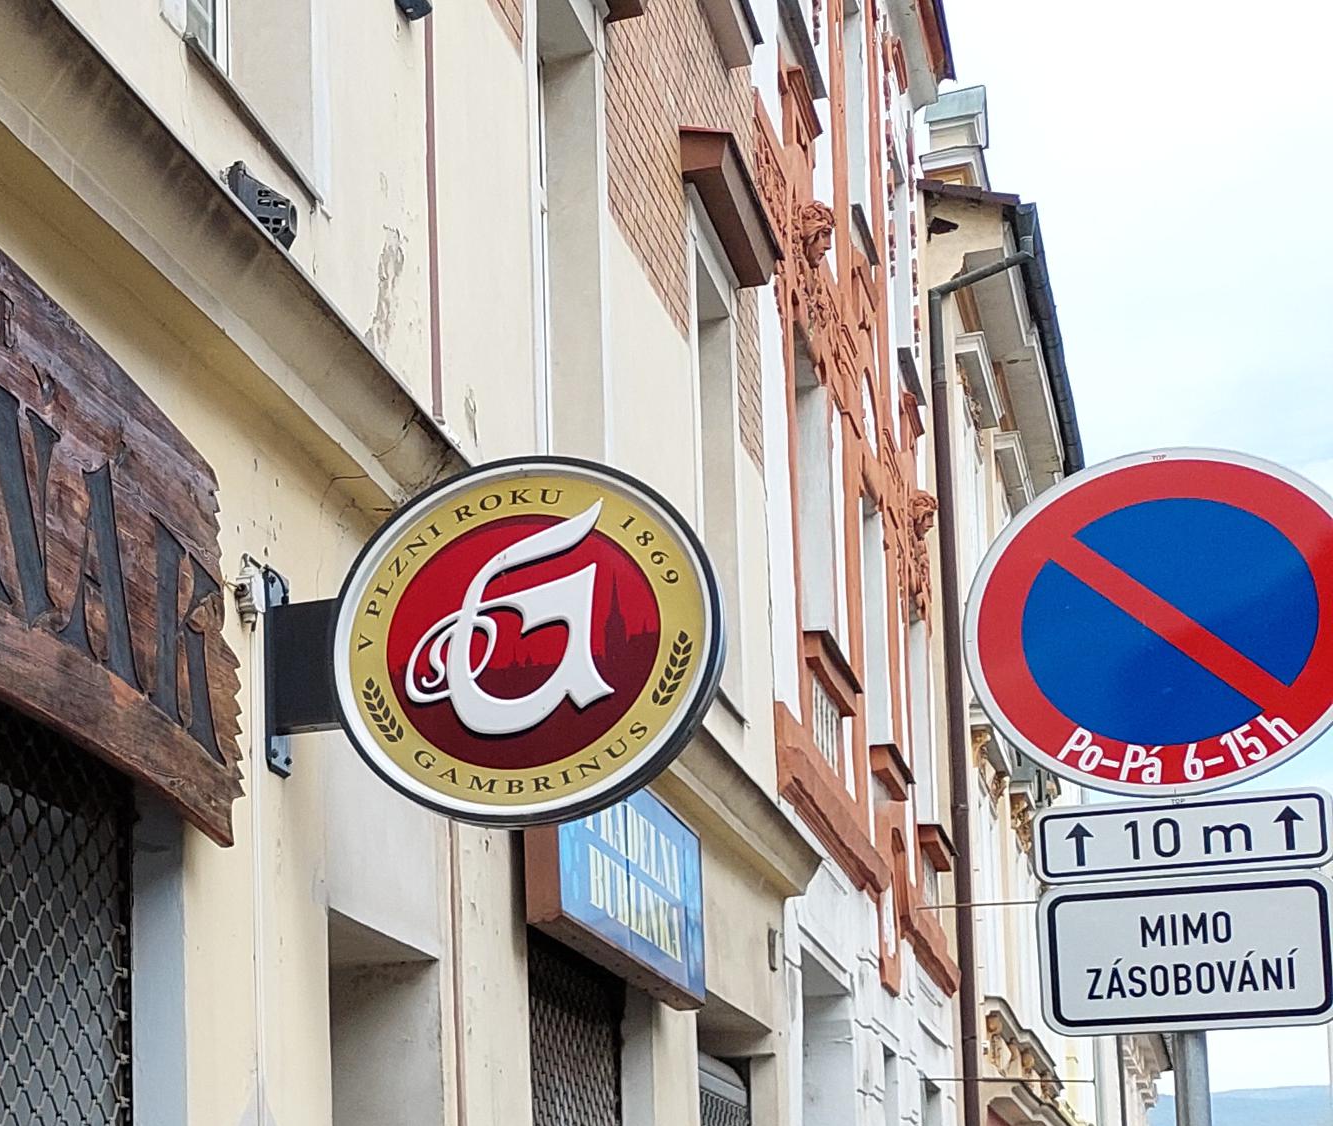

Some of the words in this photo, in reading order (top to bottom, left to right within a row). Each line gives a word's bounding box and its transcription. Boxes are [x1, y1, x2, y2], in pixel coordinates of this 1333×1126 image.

[357, 633, 371, 653] V
[364, 525, 442, 620] PLZNI
[454, 487, 565, 524] ROKU
[619, 514, 680, 586] 1869
[412, 719, 650, 796] GAMBRINUS
[1056, 726, 1163, 784] Po-Pá
[1183, 724, 1268, 781] 6-15
[1265, 713, 1299, 745] h
[1125, 817, 1182, 861] 10
[1202, 822, 1253, 854] m
[1140, 911, 1232, 948] MIMO
[1086, 948, 1297, 1001] ZÁSOBOVÁNÍ
